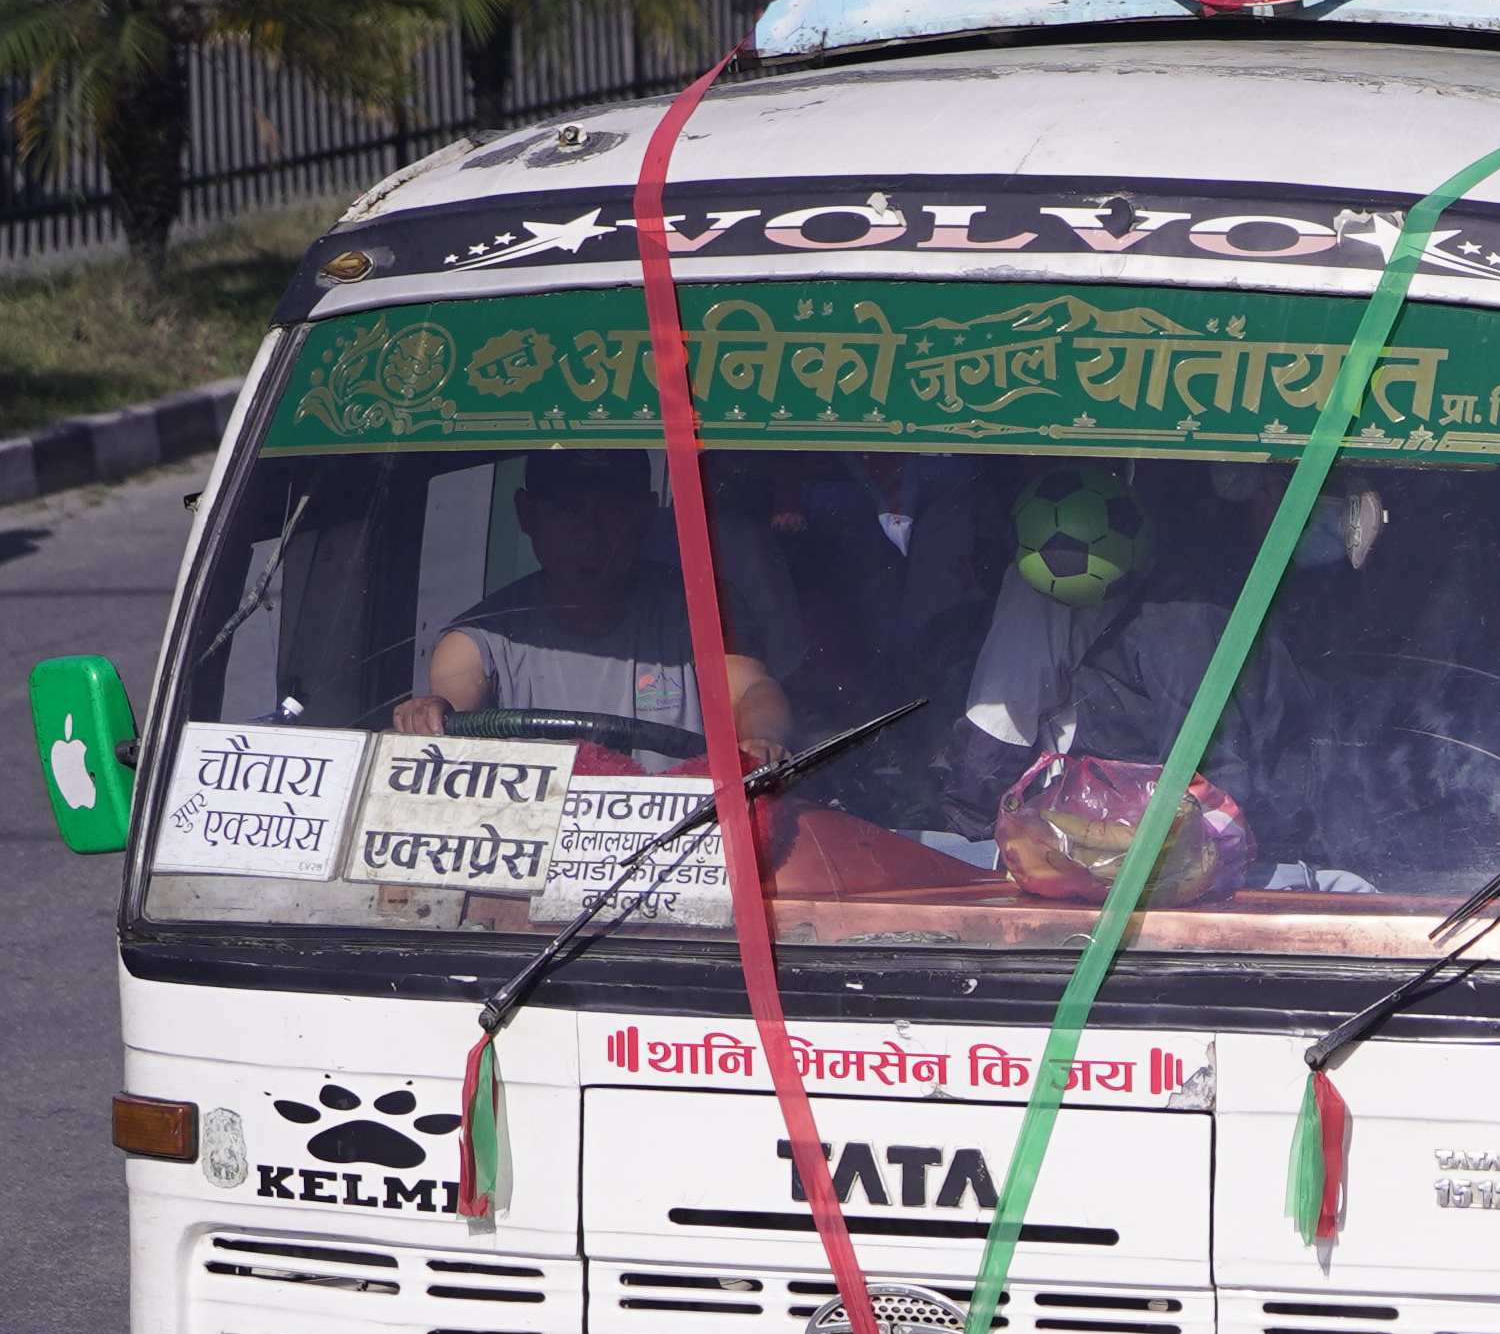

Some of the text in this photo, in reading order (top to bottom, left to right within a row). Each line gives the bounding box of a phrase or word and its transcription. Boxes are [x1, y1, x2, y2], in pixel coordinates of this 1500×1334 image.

[617, 204, 1338, 258] VOLVO
[560, 298, 906, 404] अनिको
[1072, 337, 1449, 423] यातायात
[198, 734, 334, 798] चौतारा
[388, 743, 557, 803] चौतारा
[203, 801, 330, 852] एक्सप्रेस
[362, 823, 549, 880] एक्सप्रेस
[646, 1032, 1137, 1093] थानि भिमसेन कि जय
[777, 1137, 1000, 1208] TATA
